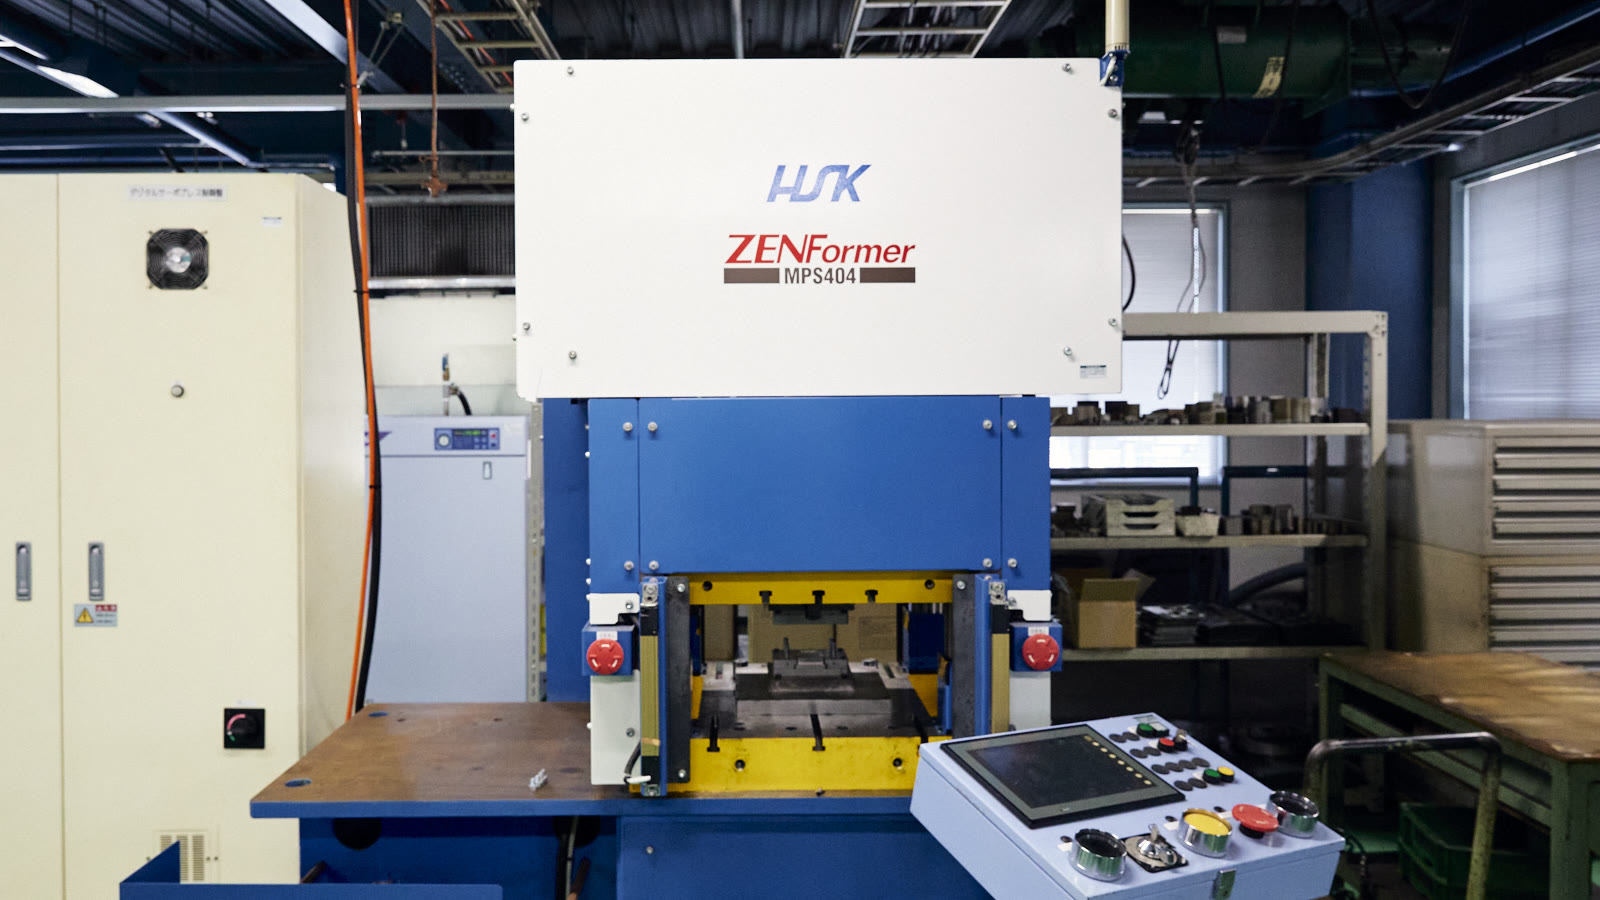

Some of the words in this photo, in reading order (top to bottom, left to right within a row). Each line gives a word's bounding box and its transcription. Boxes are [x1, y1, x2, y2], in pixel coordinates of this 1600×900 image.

[767, 164, 872, 202] HSK
[725, 234, 916, 264] ZENFormer
[784, 267, 857, 284] MPS404
